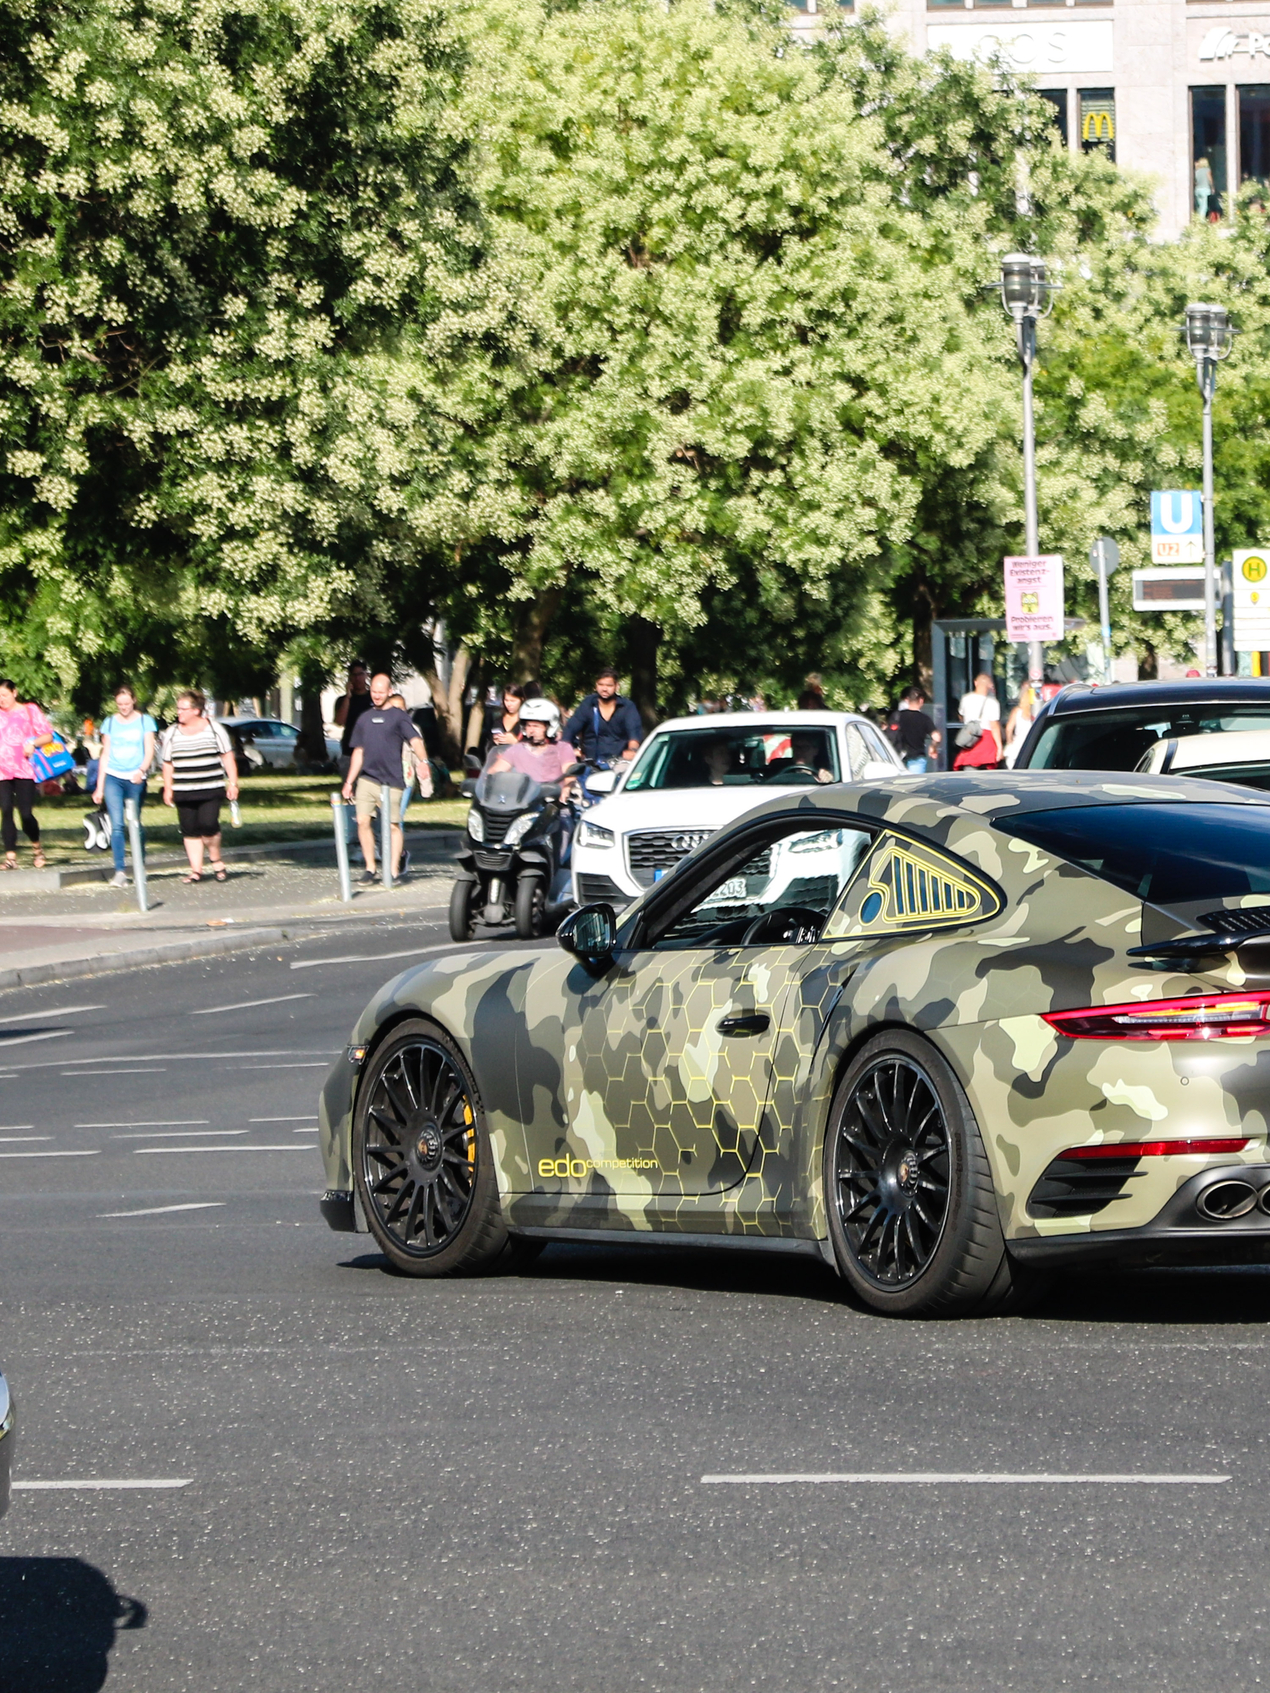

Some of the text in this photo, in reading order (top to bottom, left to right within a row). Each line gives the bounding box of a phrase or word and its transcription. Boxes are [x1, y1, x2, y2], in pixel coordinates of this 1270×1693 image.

[1161, 493, 1193, 534] U
[1159, 543, 1179, 556] U2
[1248, 562, 1260, 578] H
[538, 1153, 658, 1178] edo competition
